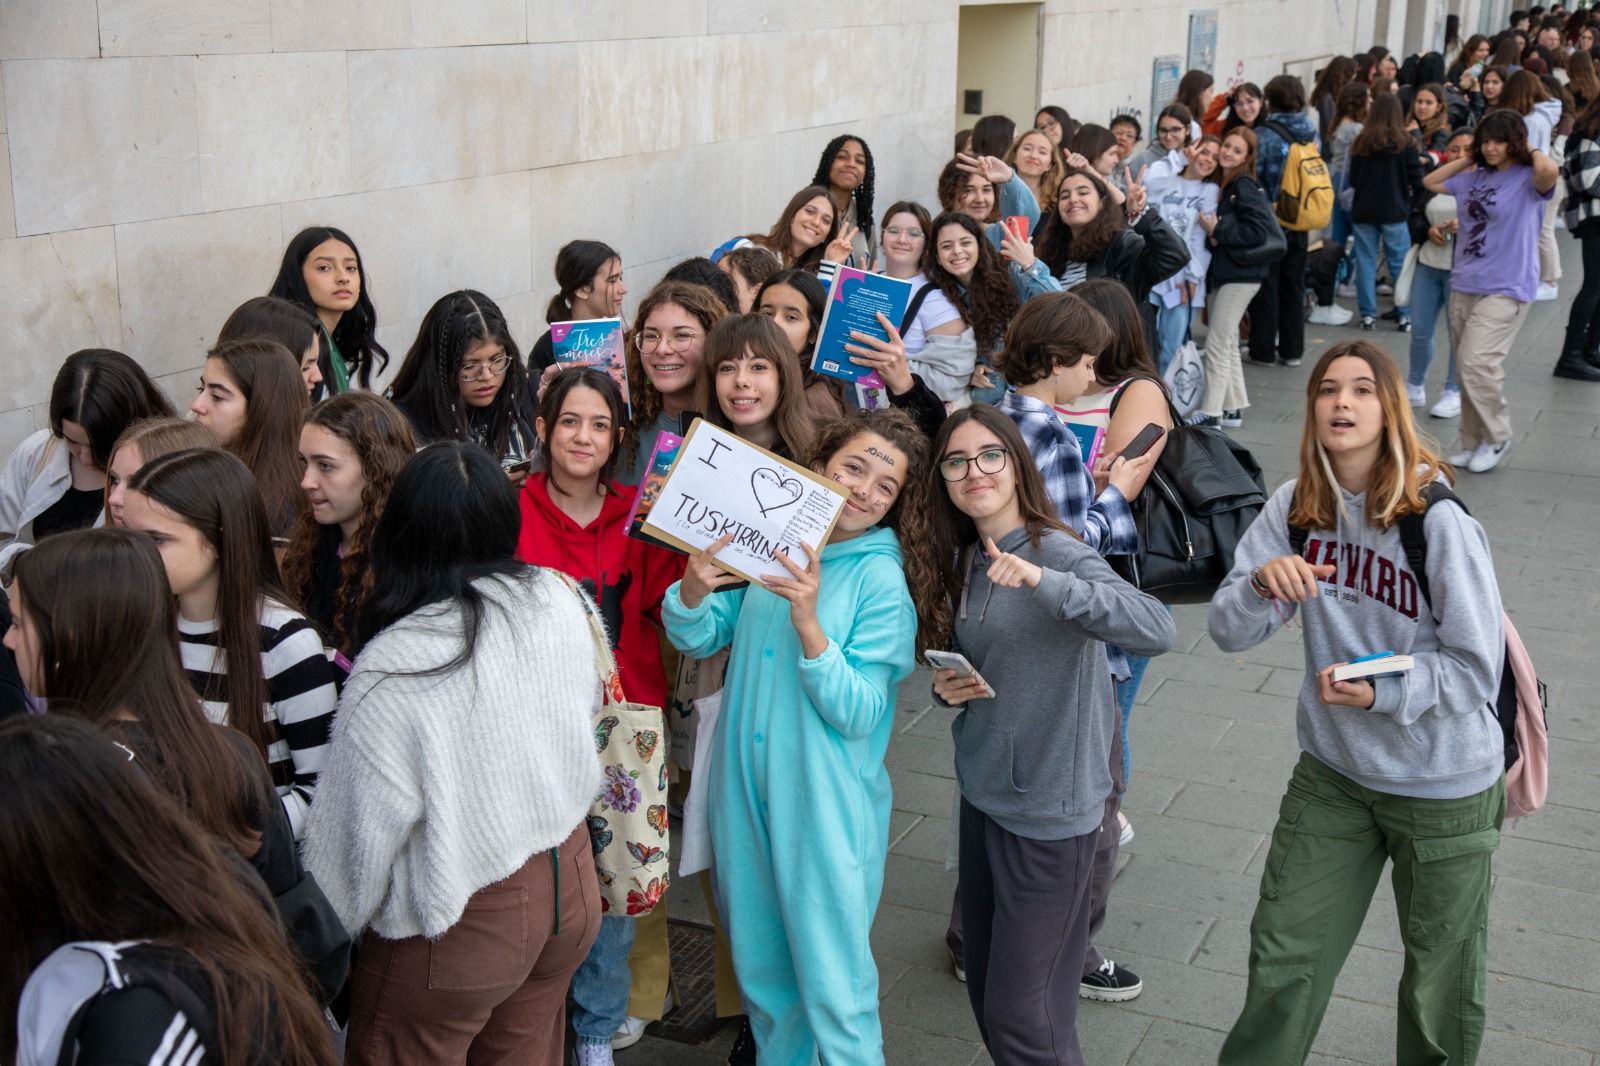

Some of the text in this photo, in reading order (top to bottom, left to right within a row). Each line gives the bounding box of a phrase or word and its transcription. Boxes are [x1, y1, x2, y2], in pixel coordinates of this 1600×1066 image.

[571, 328, 608, 351] Tres
[559, 347, 612, 362] meses
[698, 437, 732, 470] I
[864, 447, 895, 466] JOANA
